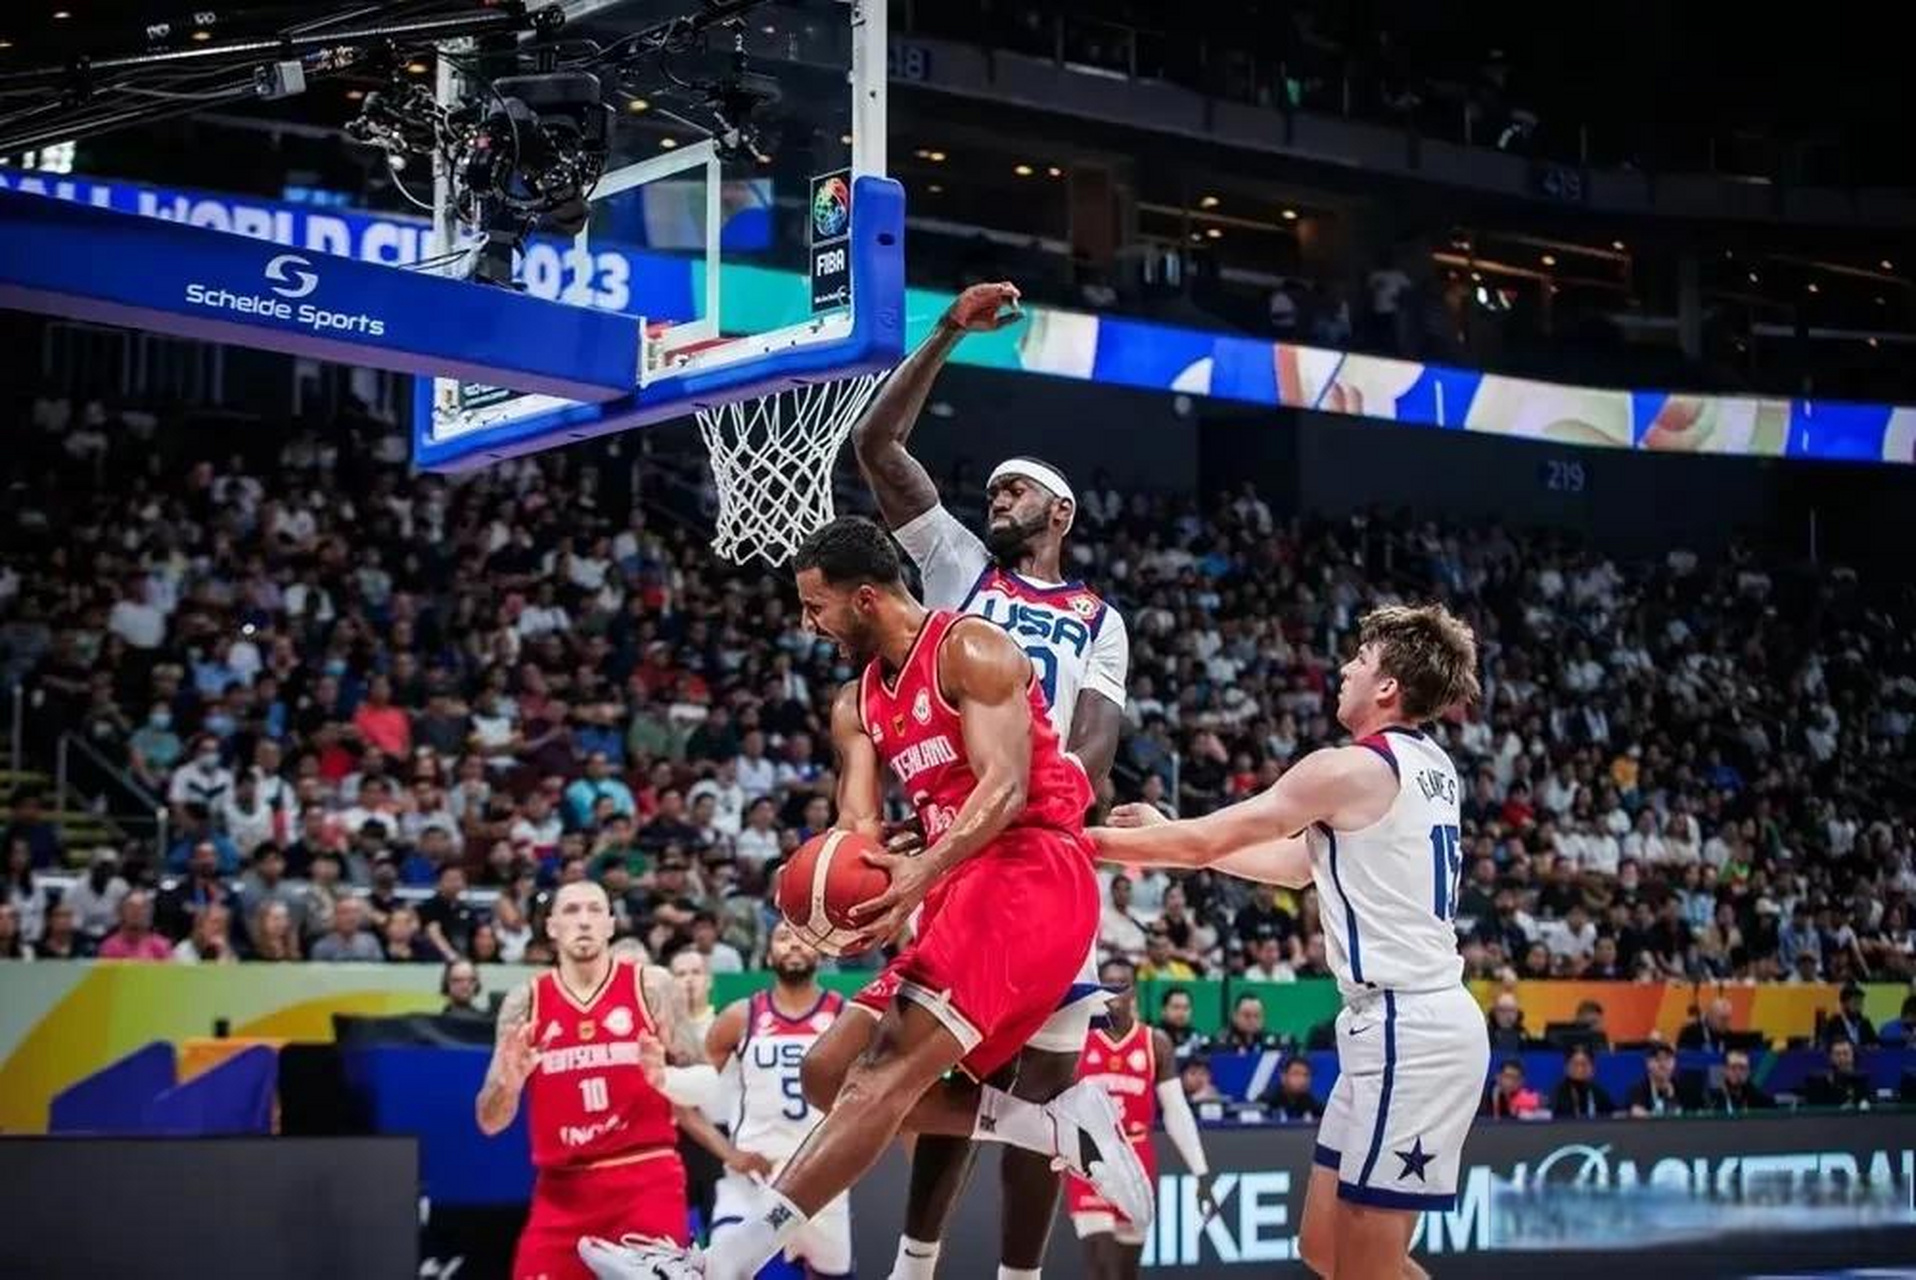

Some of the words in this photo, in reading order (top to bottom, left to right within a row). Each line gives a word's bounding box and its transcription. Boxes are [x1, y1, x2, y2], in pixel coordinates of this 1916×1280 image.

[816, 249, 845, 277] FIBA
[186, 284, 292, 320] Schelde
[297, 304, 385, 336] Sports
[1546, 459, 1586, 492] 219
[983, 598, 1089, 659] USA
[578, 1077, 610, 1113] 10
[781, 1076, 809, 1121] 5
